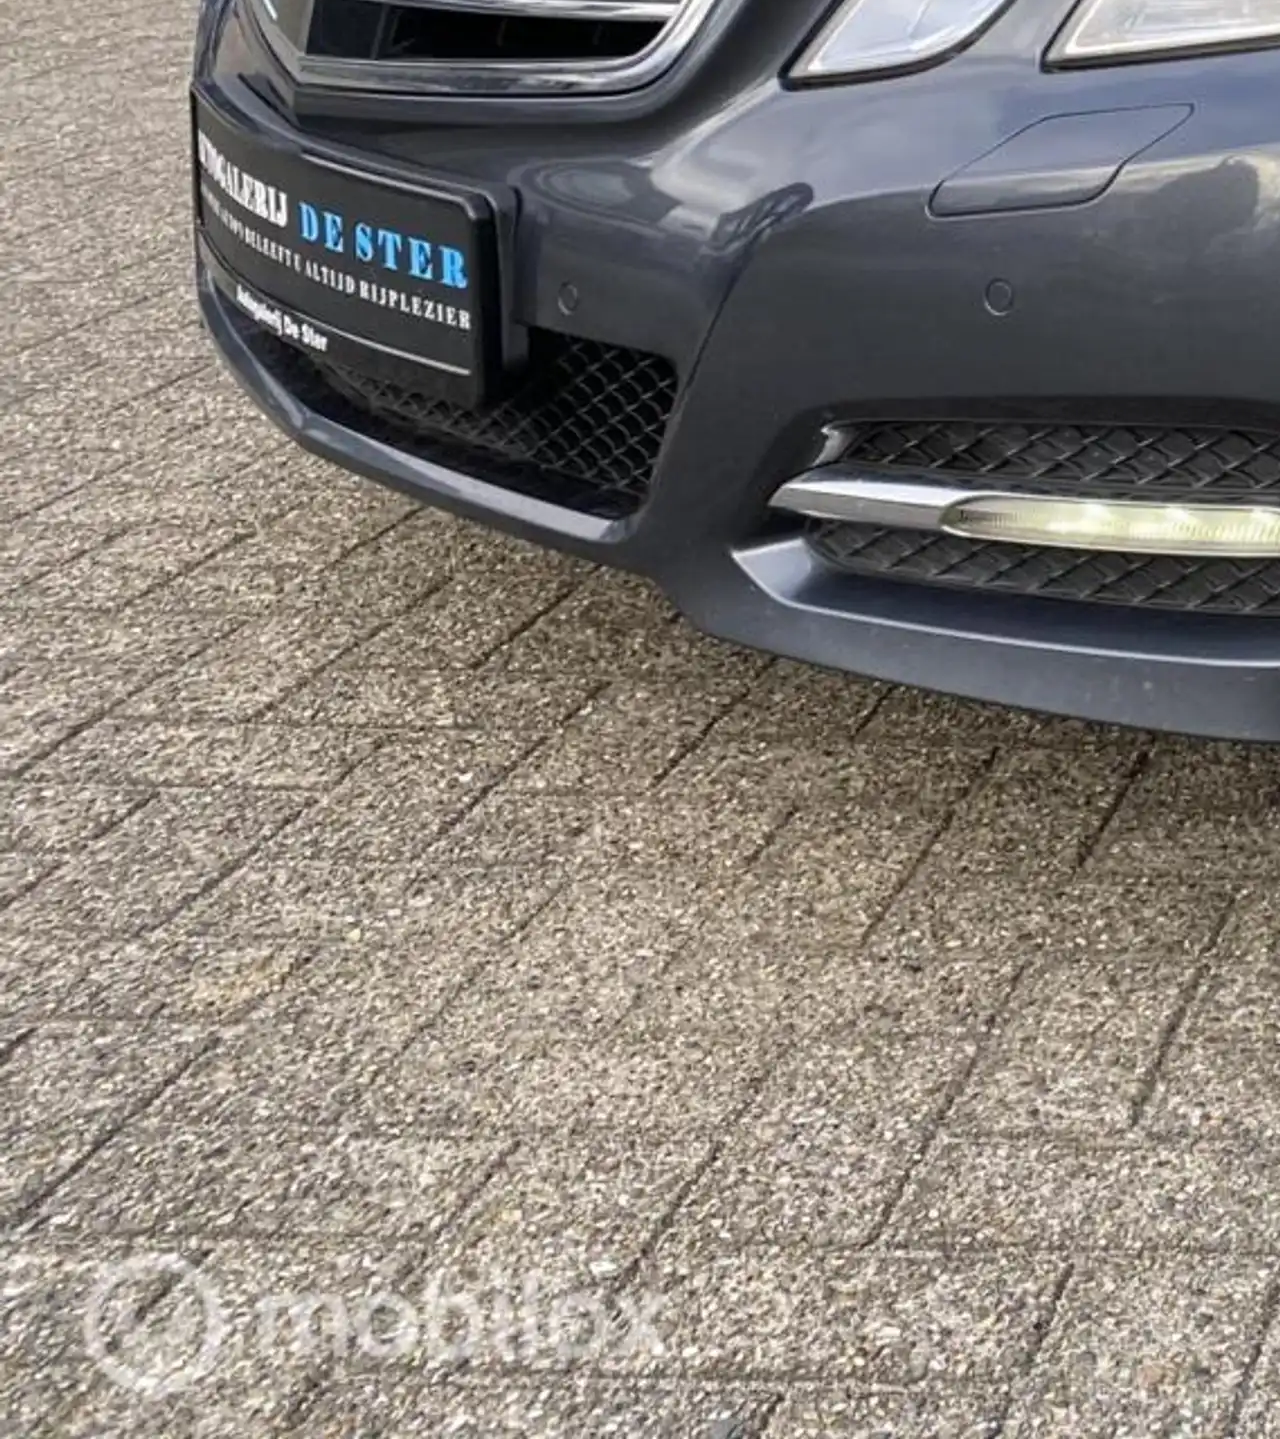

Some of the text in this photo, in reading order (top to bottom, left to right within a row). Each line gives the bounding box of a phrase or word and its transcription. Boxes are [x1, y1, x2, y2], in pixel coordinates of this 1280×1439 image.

[299, 200, 345, 253] DE
[355, 222, 468, 289] STER
[304, 259, 356, 295] ALTIJD
[359, 279, 471, 331] RIJPLEZIER
